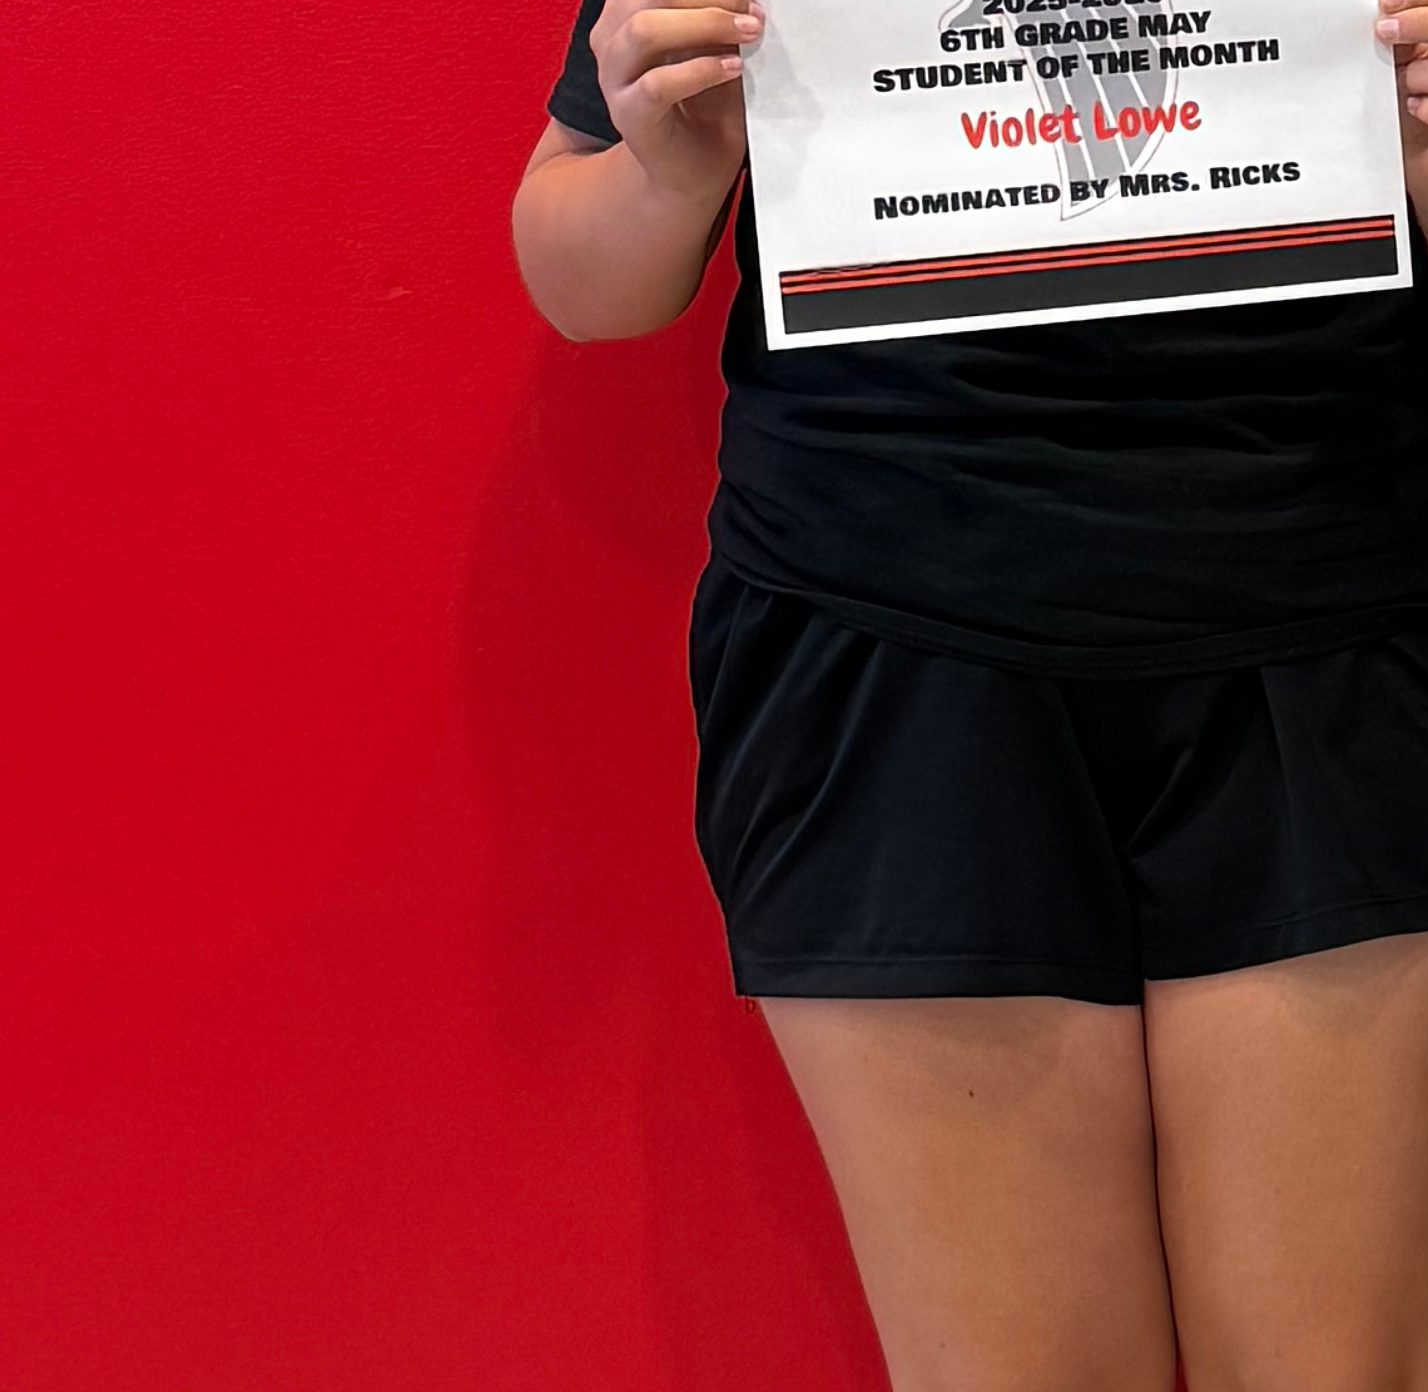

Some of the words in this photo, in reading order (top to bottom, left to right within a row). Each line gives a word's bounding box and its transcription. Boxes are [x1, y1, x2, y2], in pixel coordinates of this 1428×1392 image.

[940, 26, 1005, 53] 6TH
[1014, 16, 1130, 47] GRADE
[1138, 10, 1211, 38] MAY
[873, 59, 1028, 93] STUDENT
[1036, 54, 1079, 79] OF
[1086, 48, 1151, 75] THE
[1159, 38, 1280, 70] MONTH
[961, 106, 1081, 148] Violet
[1094, 100, 1202, 141] Lowe
